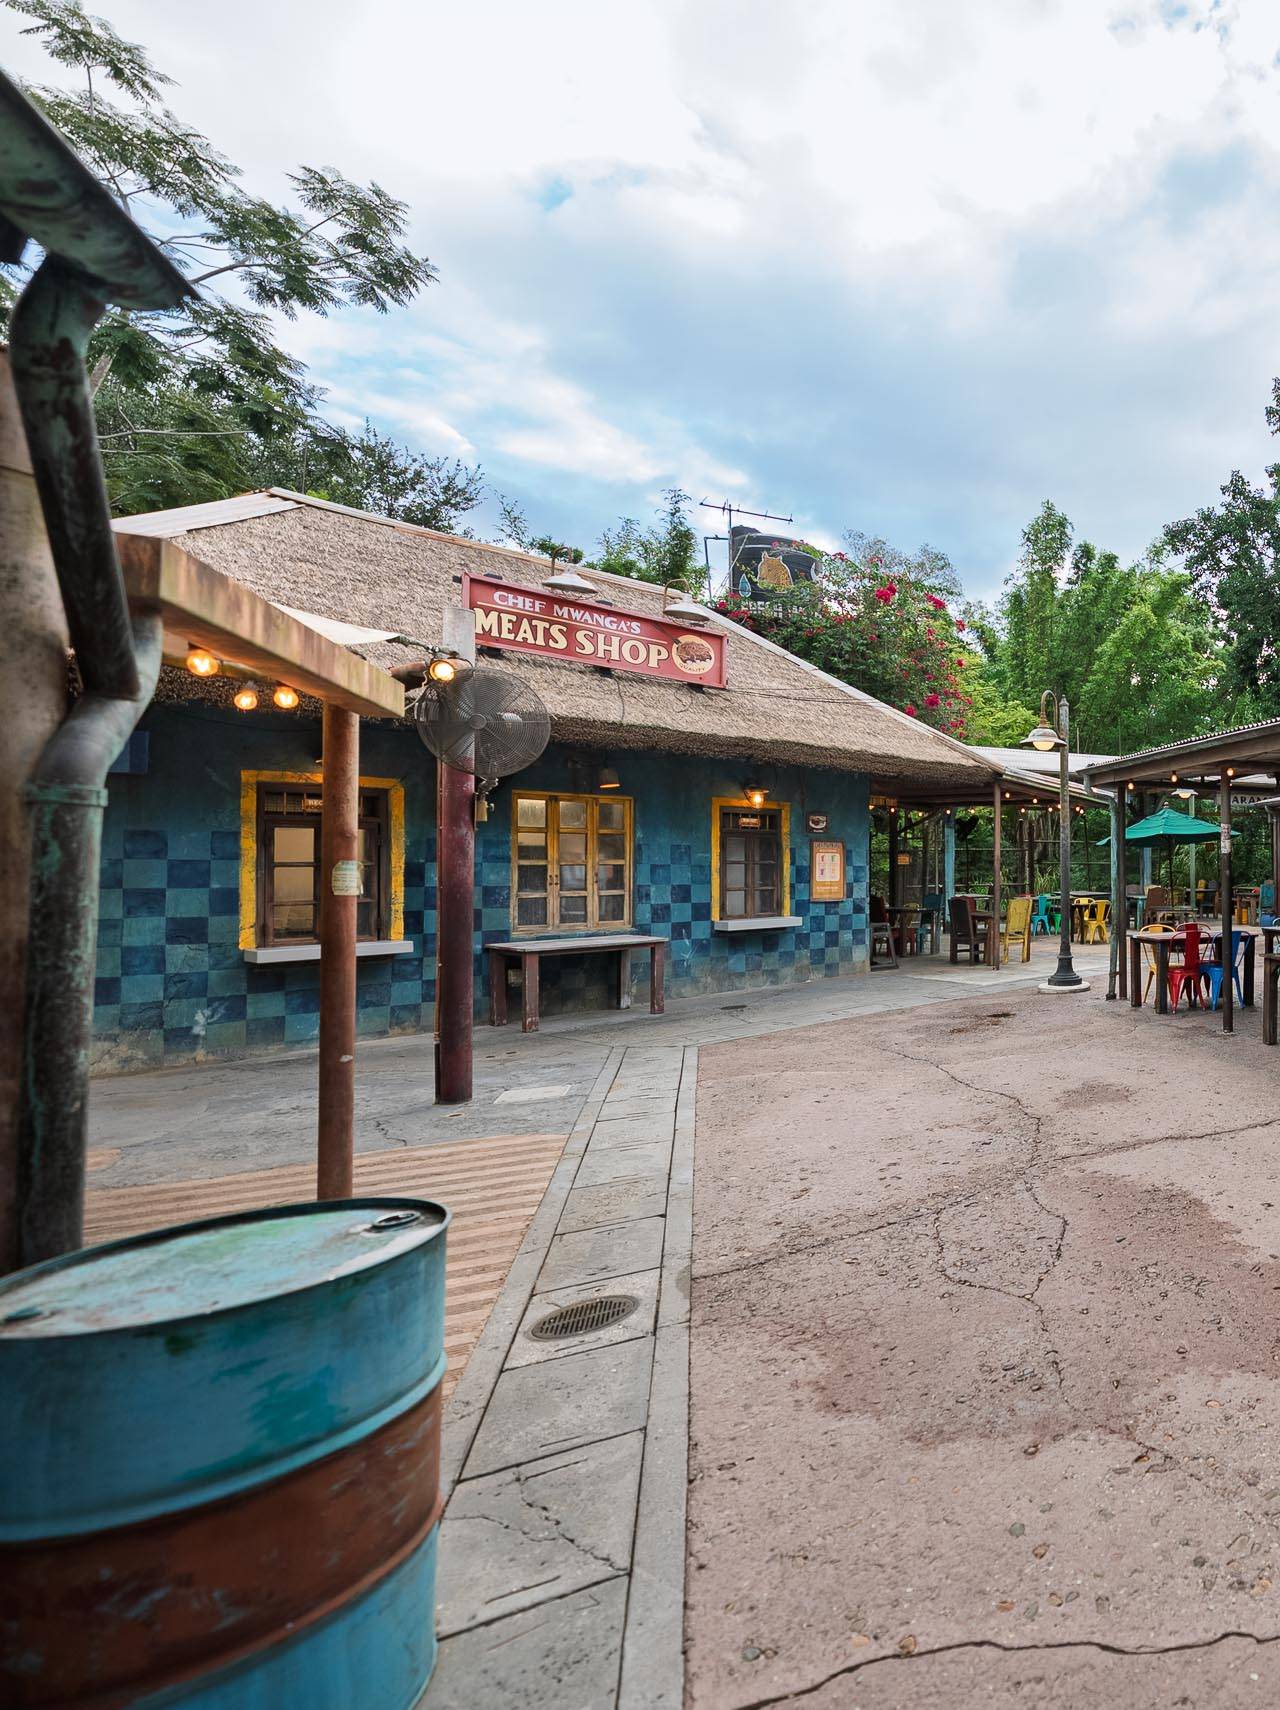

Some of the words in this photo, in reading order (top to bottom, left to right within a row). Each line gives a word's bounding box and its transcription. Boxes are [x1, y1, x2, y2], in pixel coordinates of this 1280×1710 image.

[474, 607, 568, 650] MEATS
[575, 629, 669, 669] SHOP
[493, 591, 546, 613] CHEF
[553, 604, 641, 635] MWANGA'S
